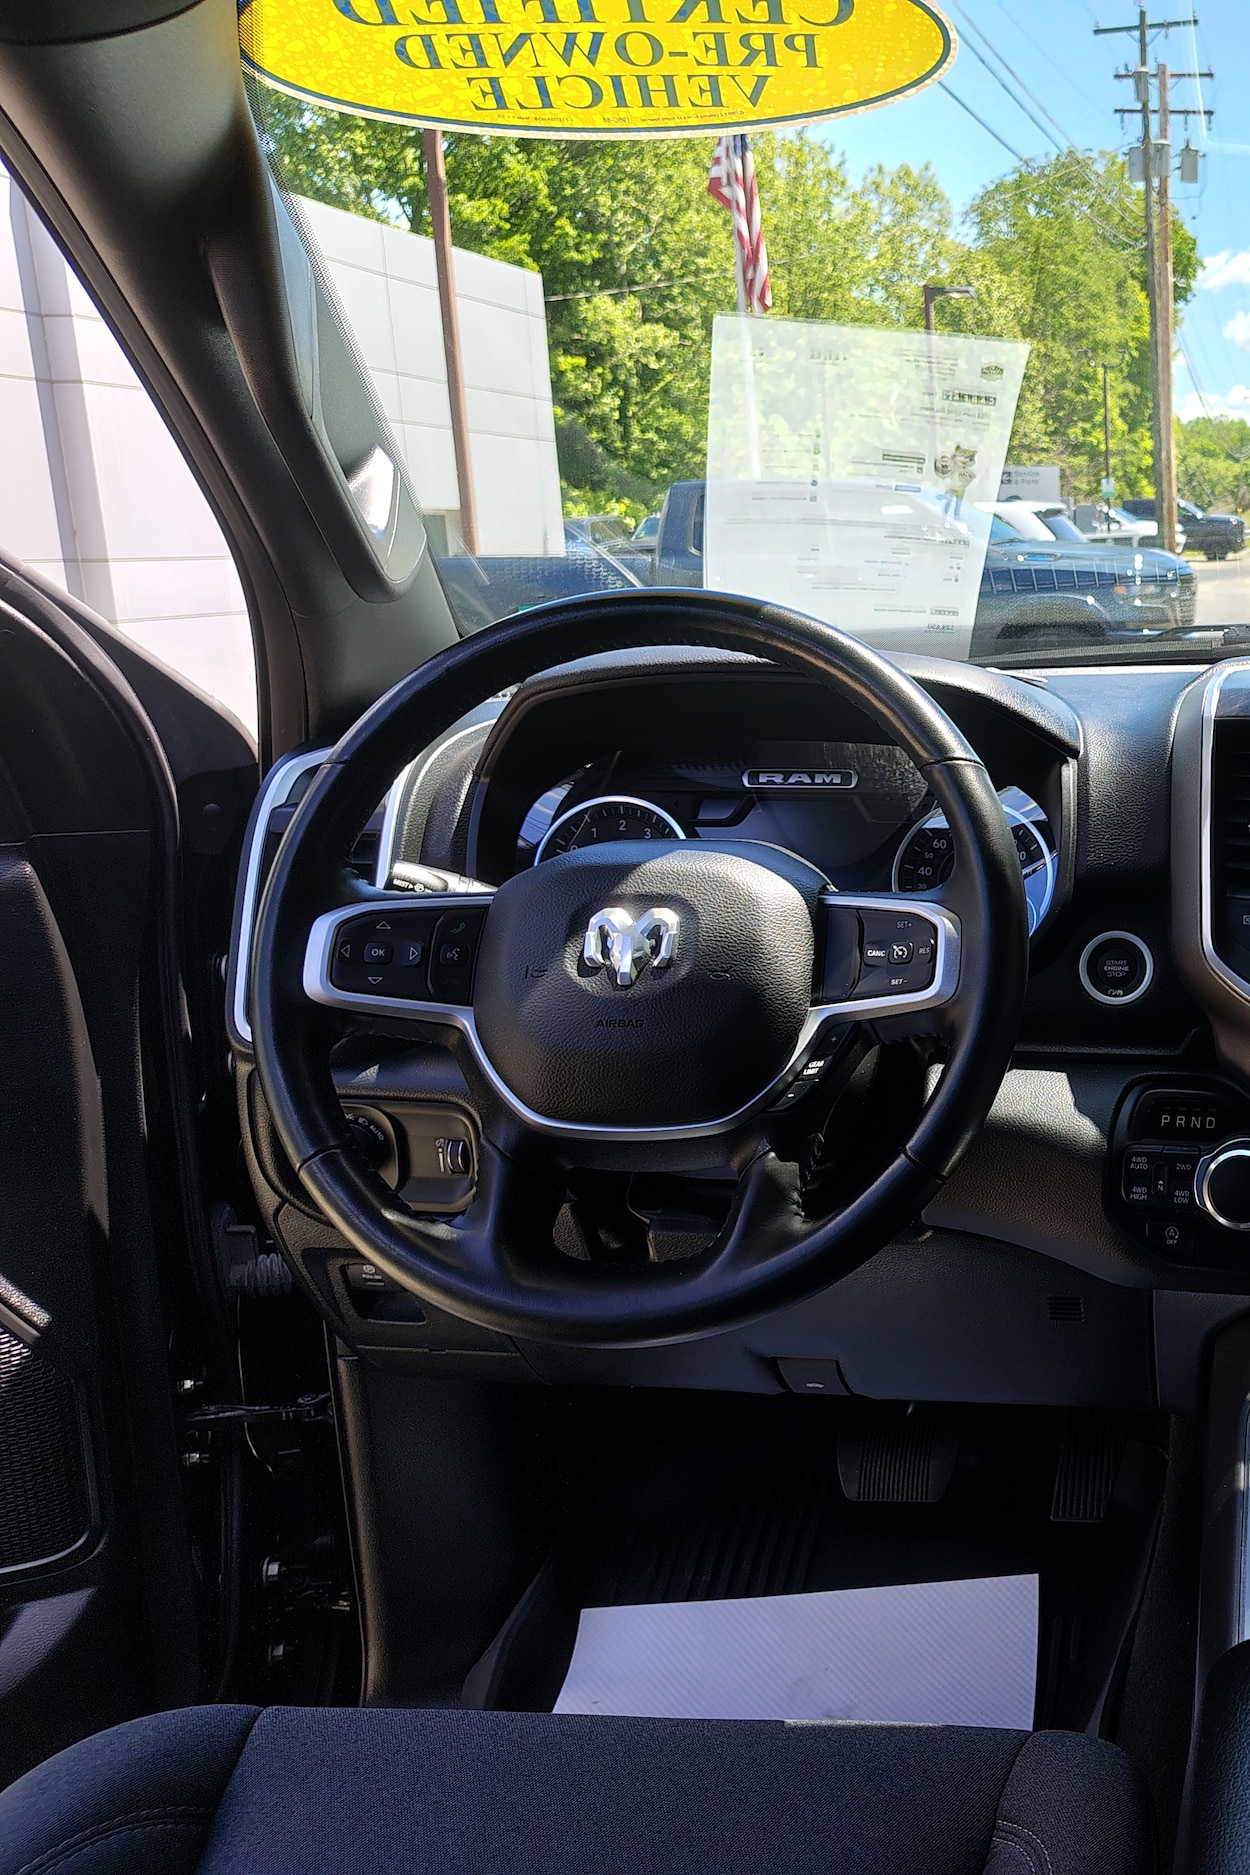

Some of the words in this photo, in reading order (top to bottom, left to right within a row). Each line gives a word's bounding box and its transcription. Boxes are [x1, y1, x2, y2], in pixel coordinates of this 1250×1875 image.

[758, 772, 842, 784] RAM
[619, 820, 627, 831] 2
[591, 828, 598, 838] 1
[643, 828, 652, 840] 3
[932, 838, 947, 849] 60
[924, 851, 934, 859] 50
[917, 866, 933, 876] 40
[371, 948, 386, 957] OK
[867, 949, 886, 957] CANC
[595, 1018, 645, 1029] AIRBAG
[1161, 1114, 1171, 1127] P
[1175, 1115, 1186, 1128] R
[1190, 1116, 1201, 1129] N
[1205, 1117, 1216, 1129] D
[1129, 1162, 1149, 1170] AUTO
[1175, 1163, 1192, 1171] 2WD
[1131, 1186, 1148, 1194] 4WD
[1130, 1193, 1148, 1201] HIGH
[1173, 1196, 1190, 1204] LOW
